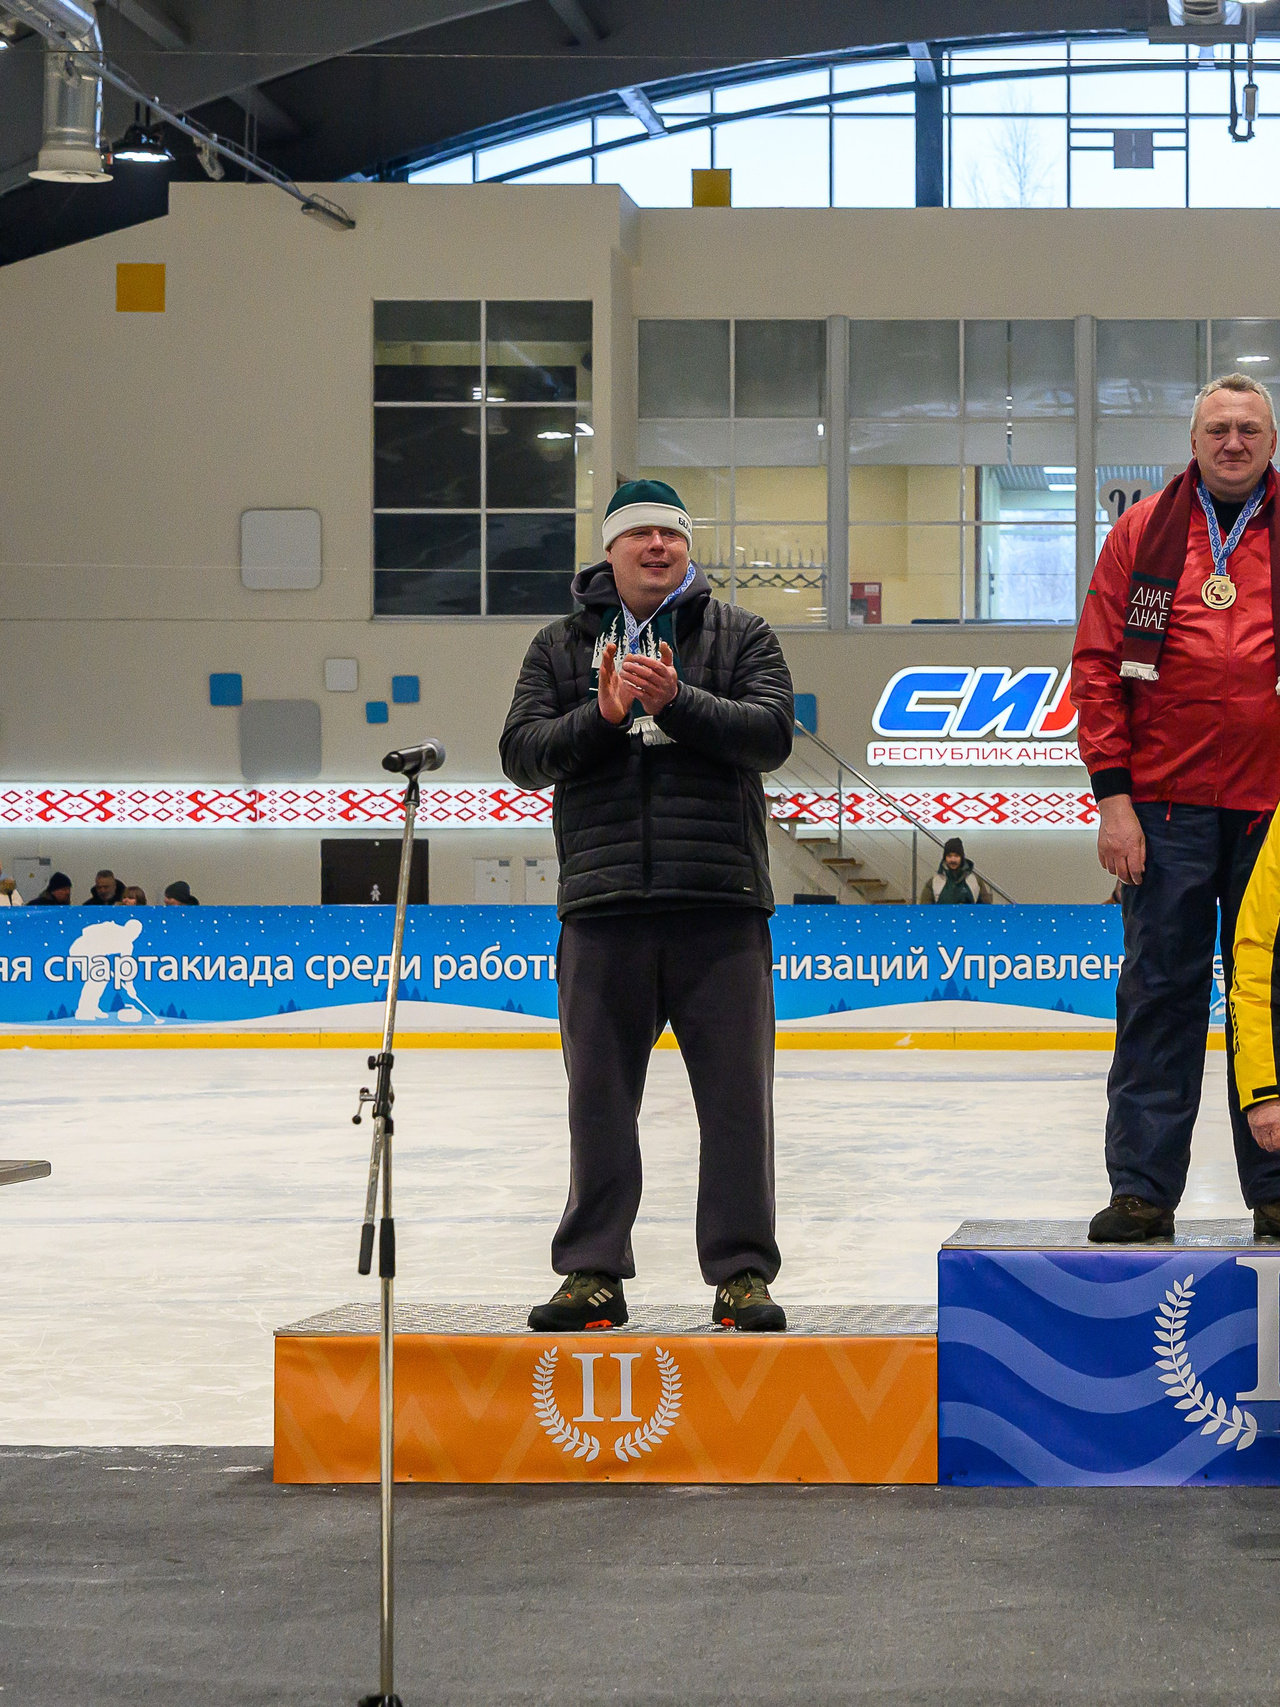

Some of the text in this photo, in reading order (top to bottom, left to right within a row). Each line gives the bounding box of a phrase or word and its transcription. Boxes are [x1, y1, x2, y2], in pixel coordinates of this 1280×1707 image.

[873, 747, 1079, 760] РЕСПУБЛИКАНСК
[44, 955, 292, 990] спартакиада
[305, 955, 421, 990] среди
[571, 1353, 643, 1422] II
